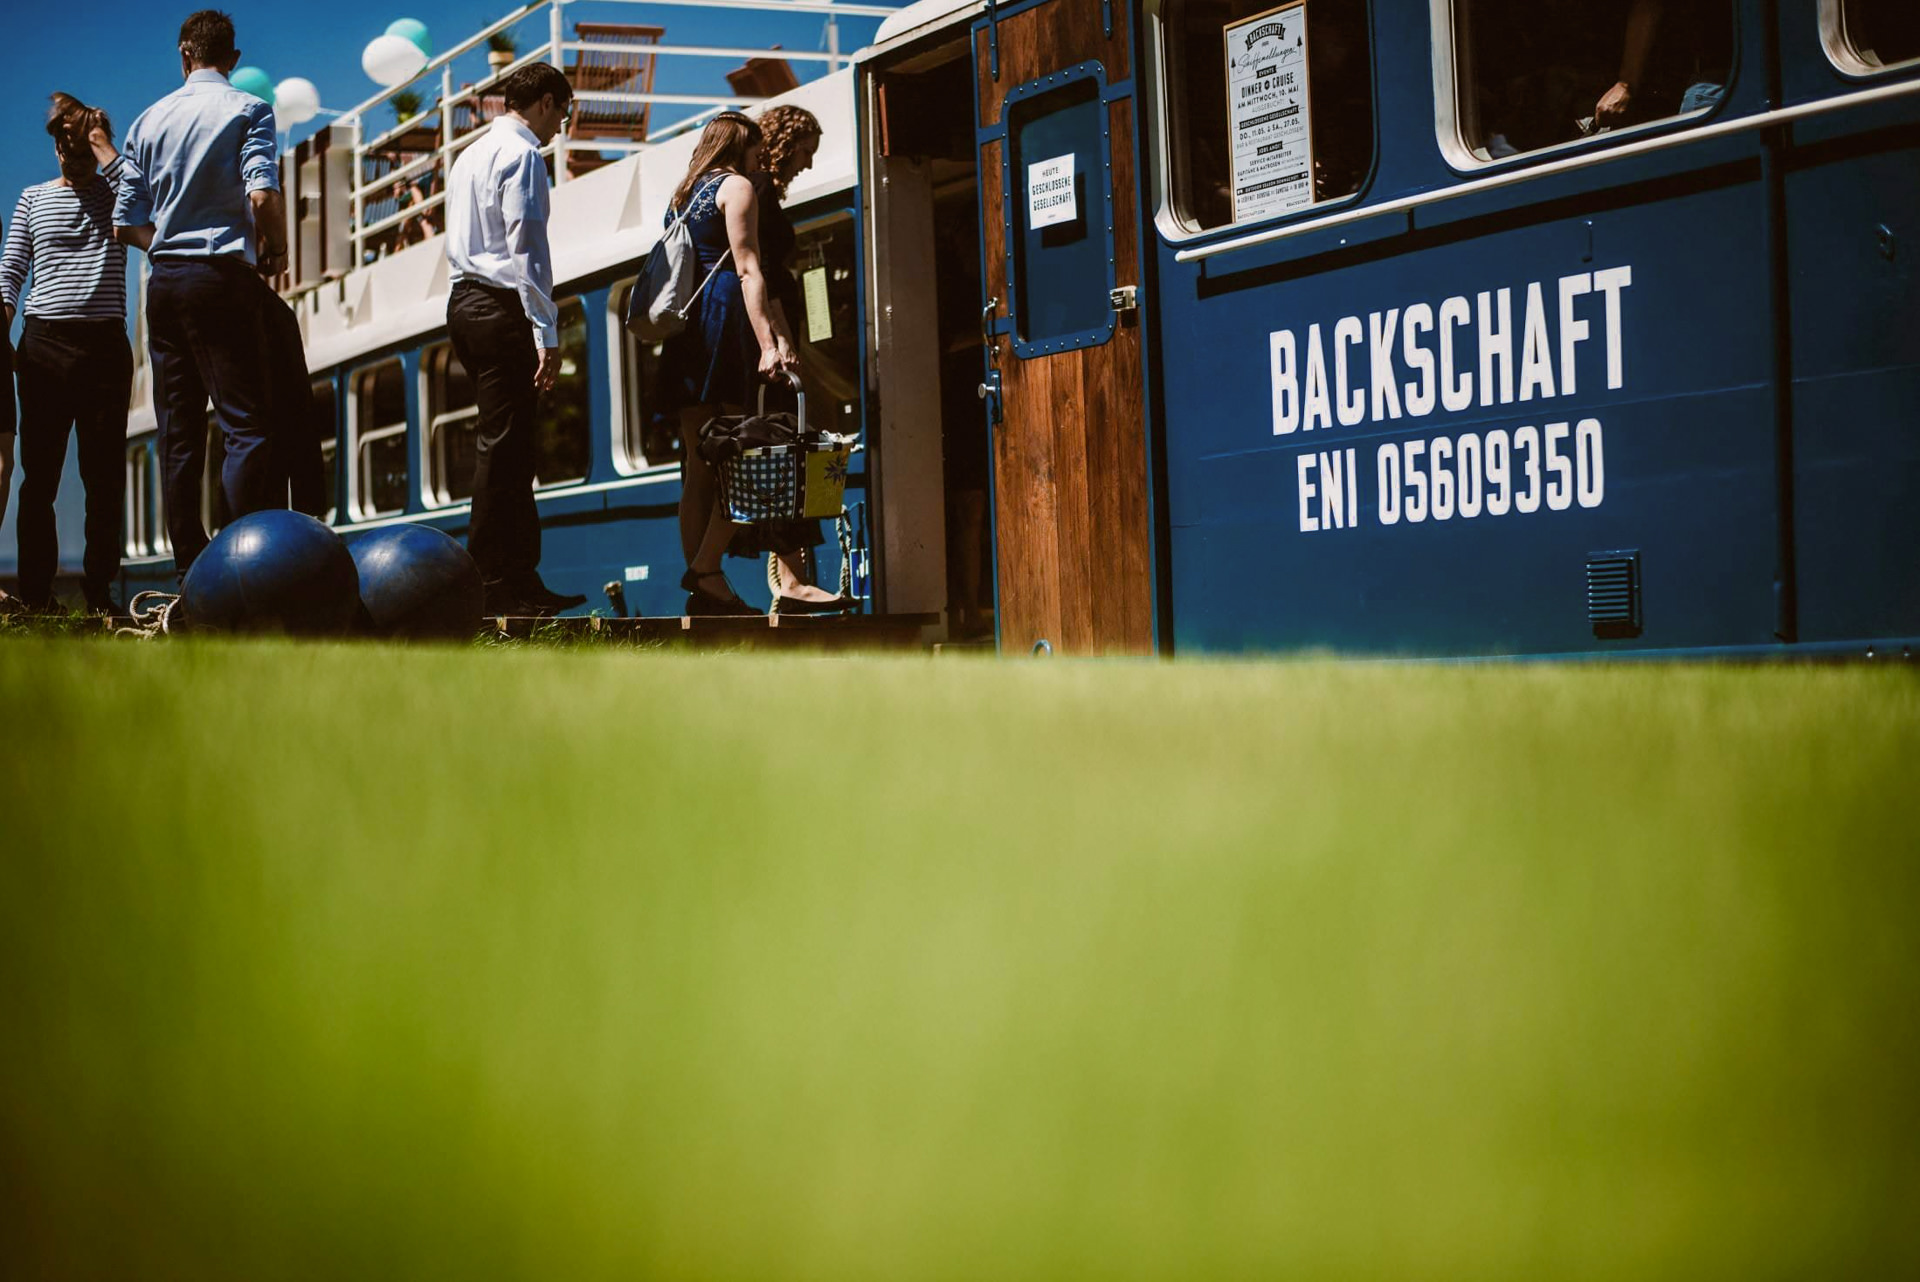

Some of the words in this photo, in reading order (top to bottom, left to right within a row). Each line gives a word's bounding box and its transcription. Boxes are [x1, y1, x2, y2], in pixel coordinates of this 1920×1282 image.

[1241, 82, 1262, 98] DINNER
[1272, 72, 1294, 89] CRUISE
[1288, 84, 1299, 93] MAI
[1042, 166, 1059, 178] HEUTE
[1032, 175, 1072, 196] GESCHLOSSENE
[1033, 191, 1072, 212] GESELLSCHAFT
[1269, 265, 1632, 436] BACKSCHAFT
[1297, 448, 1358, 532] ENI
[1377, 418, 1604, 525] 05609350
